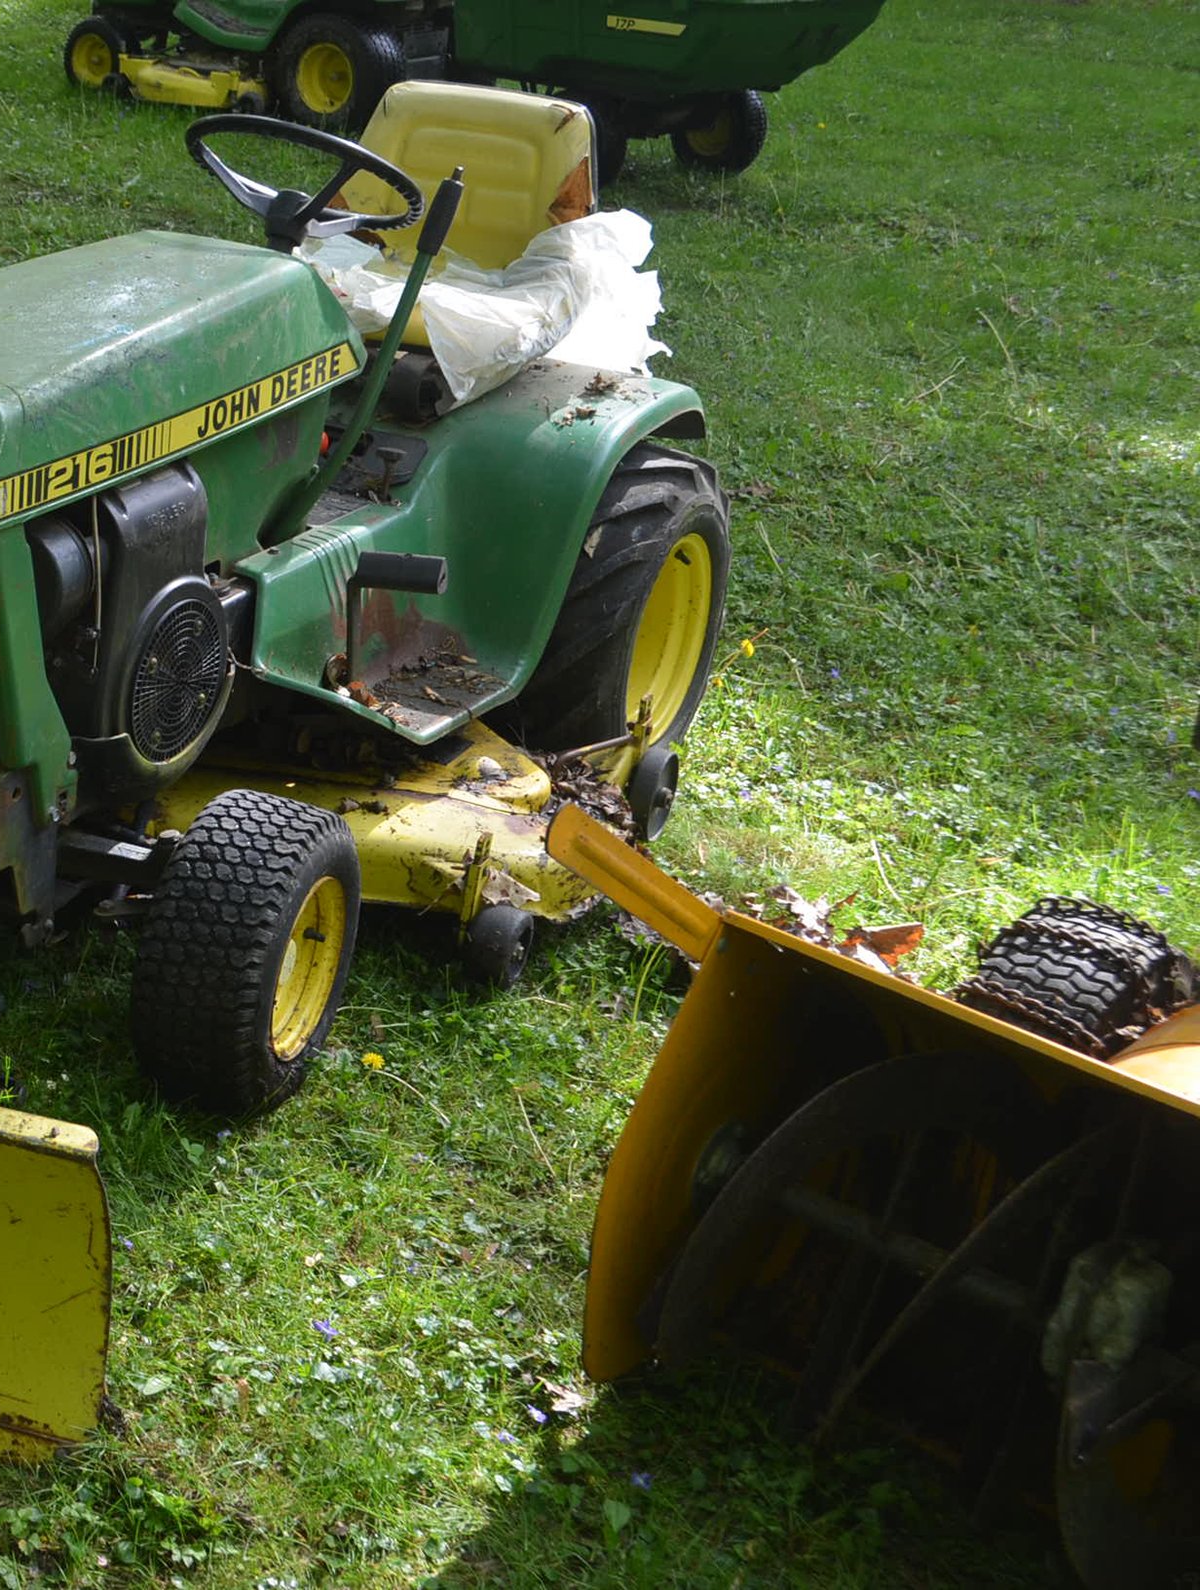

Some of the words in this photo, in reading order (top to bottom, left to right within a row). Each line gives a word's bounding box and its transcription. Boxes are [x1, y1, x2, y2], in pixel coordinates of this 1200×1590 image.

[615, 18, 636, 30] 17P
[197, 382, 261, 438] JOHN
[270, 350, 342, 407] DEERE
[46, 445, 114, 494] 216
